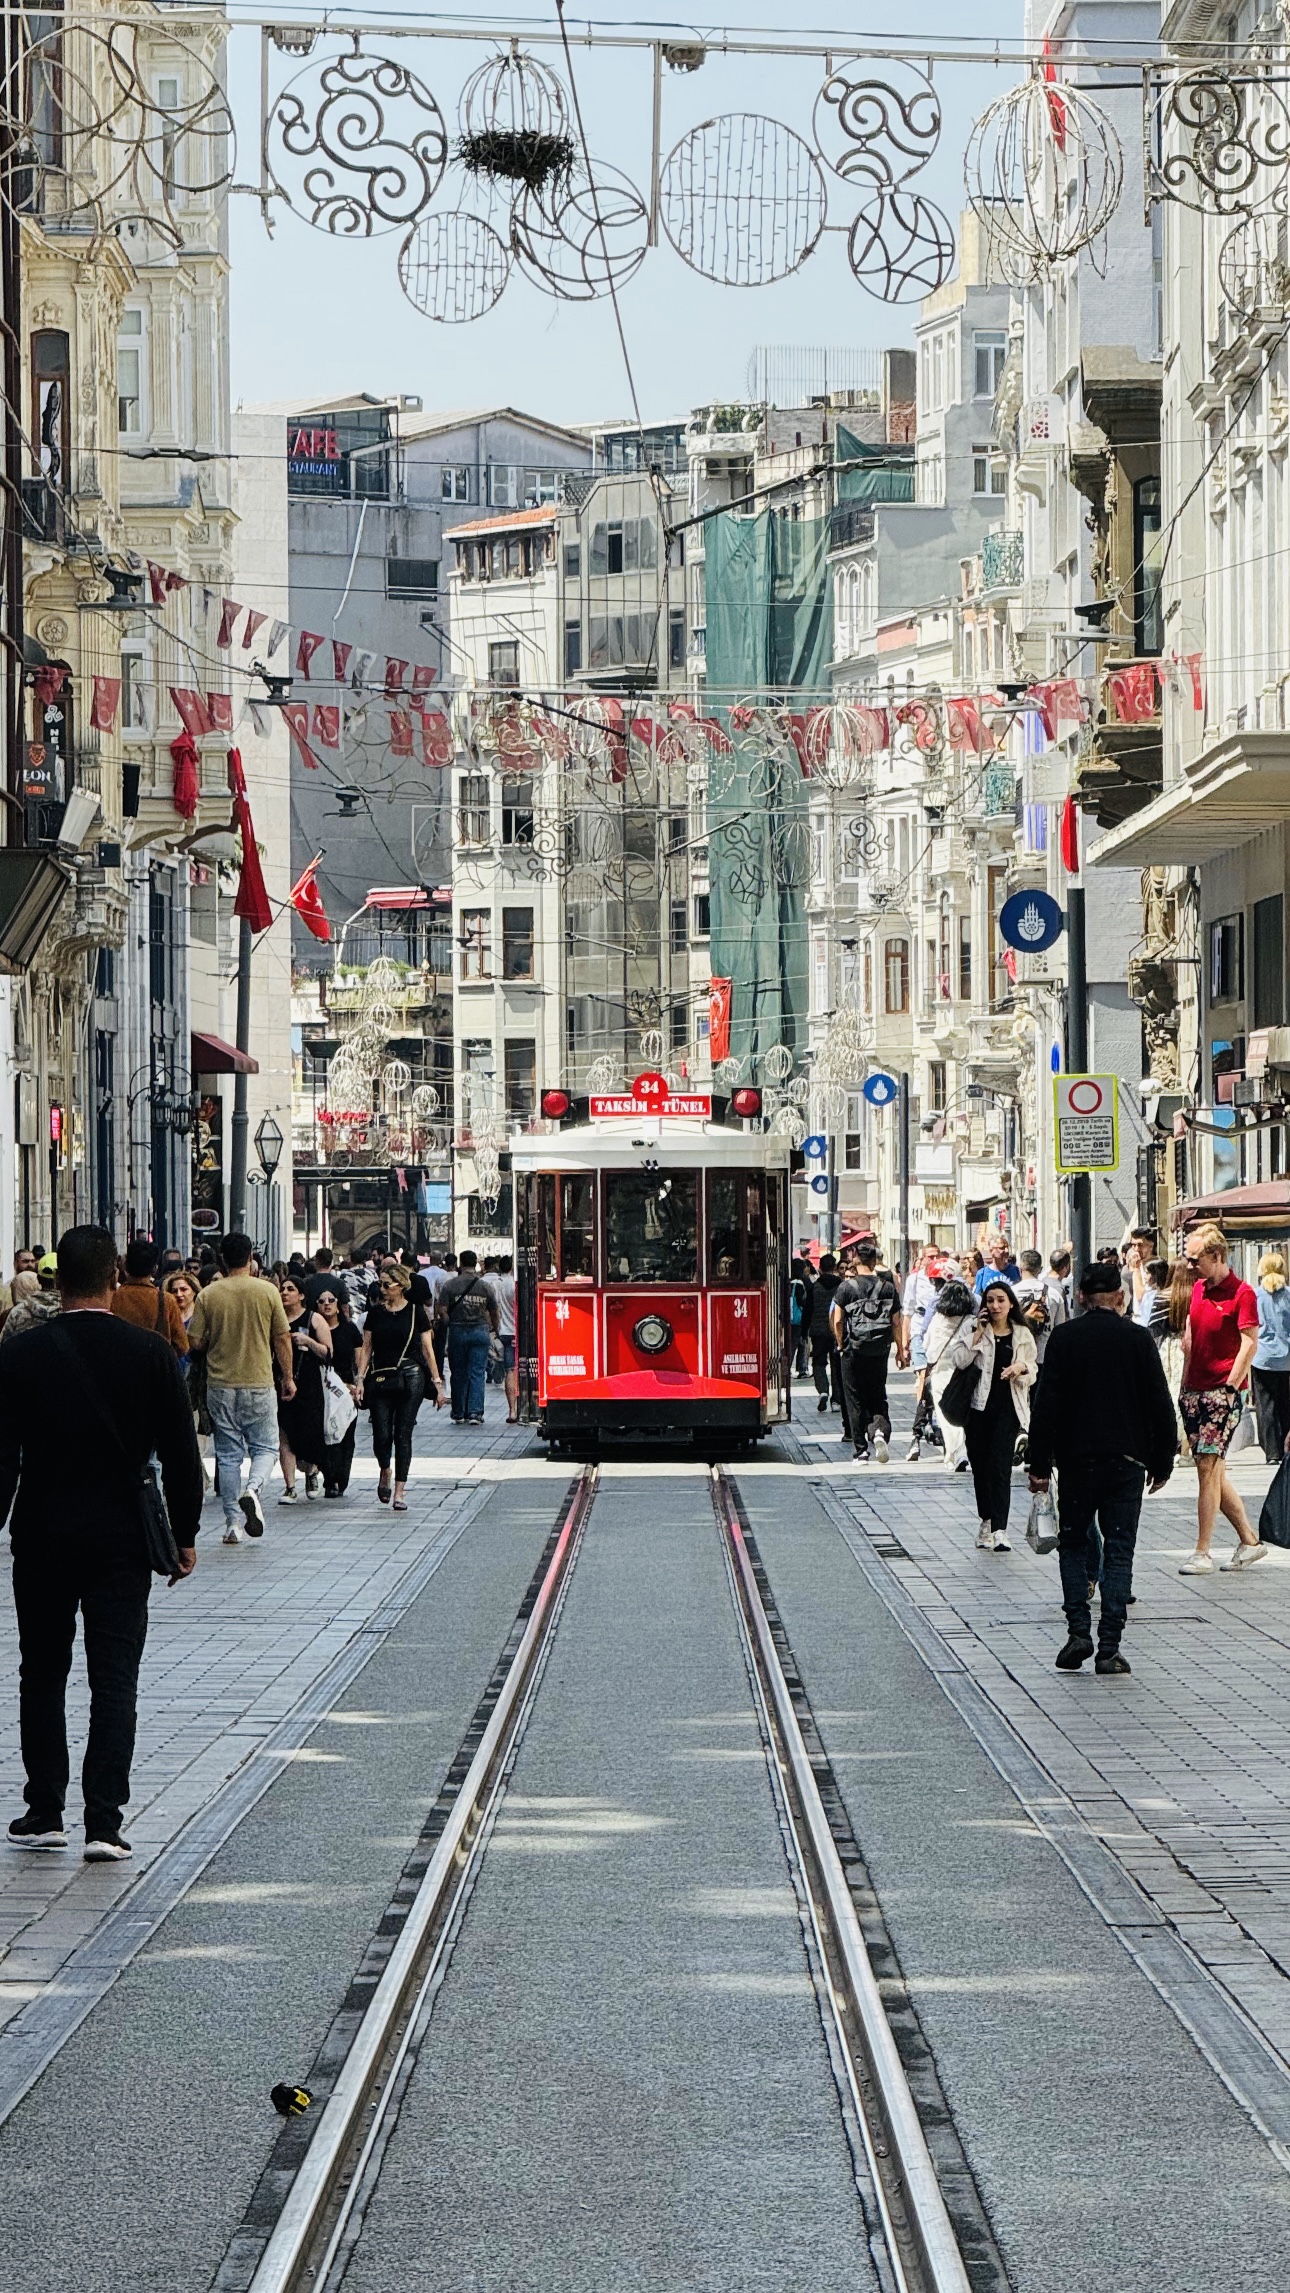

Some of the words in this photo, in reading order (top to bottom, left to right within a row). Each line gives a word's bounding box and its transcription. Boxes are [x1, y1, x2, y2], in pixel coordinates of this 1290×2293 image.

[640, 1080, 659, 1094] 34
[595, 1097, 648, 1113] TAKSİM
[662, 1097, 706, 1113] TÜNEL
[556, 1300, 570, 1319] 34
[734, 1298, 748, 1318] 34
